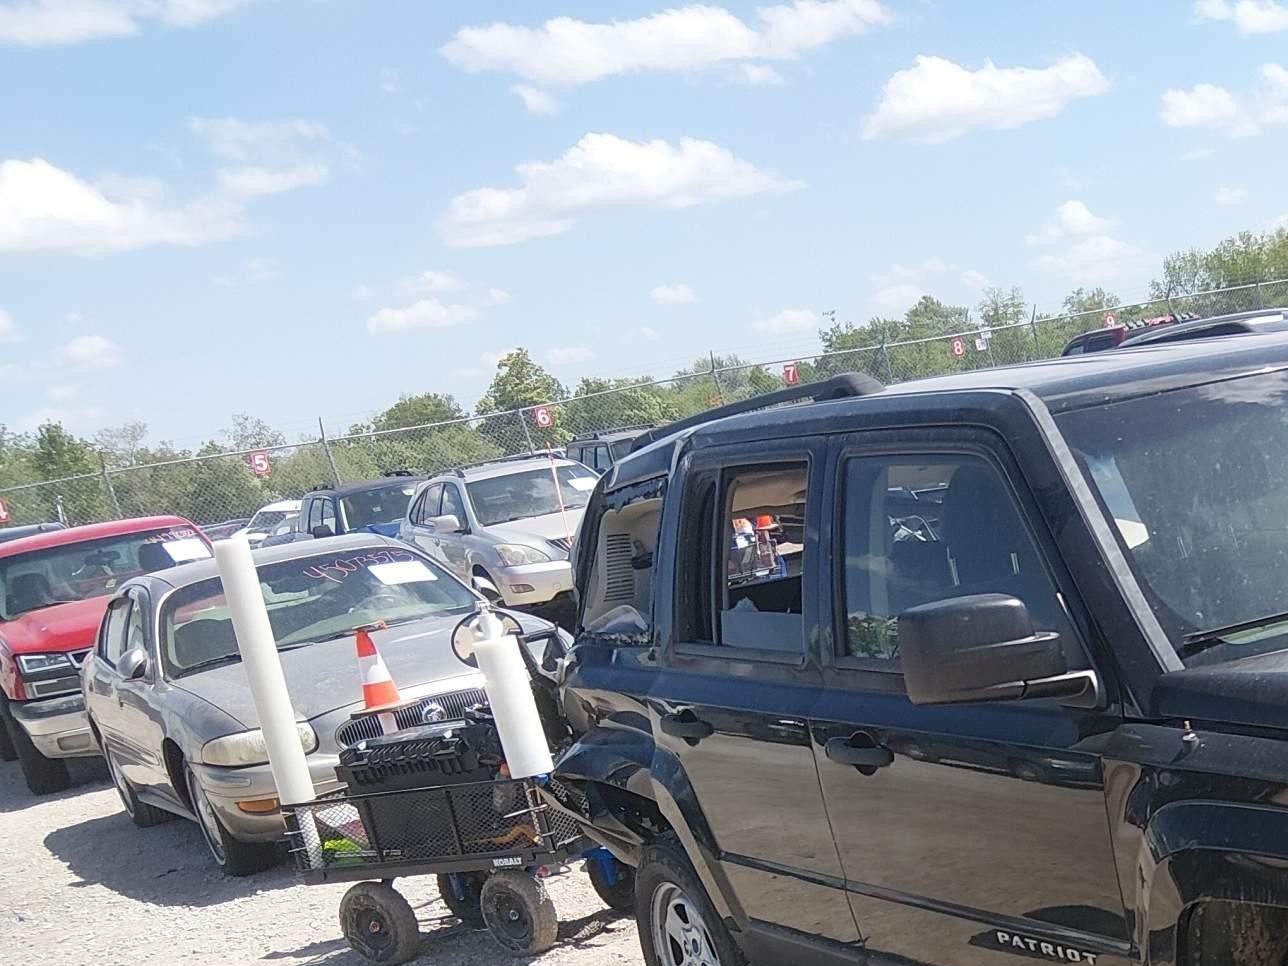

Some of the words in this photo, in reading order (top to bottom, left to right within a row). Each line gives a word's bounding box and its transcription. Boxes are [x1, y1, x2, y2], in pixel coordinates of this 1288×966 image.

[1106, 315, 1115, 329] 9
[953, 340, 963, 355] 8
[784, 366, 795, 381] 7
[537, 409, 550, 425] 6
[254, 454, 268, 471] 5
[492, 856, 522, 867] KOBALT
[996, 931, 1097, 966] PATRIOT
